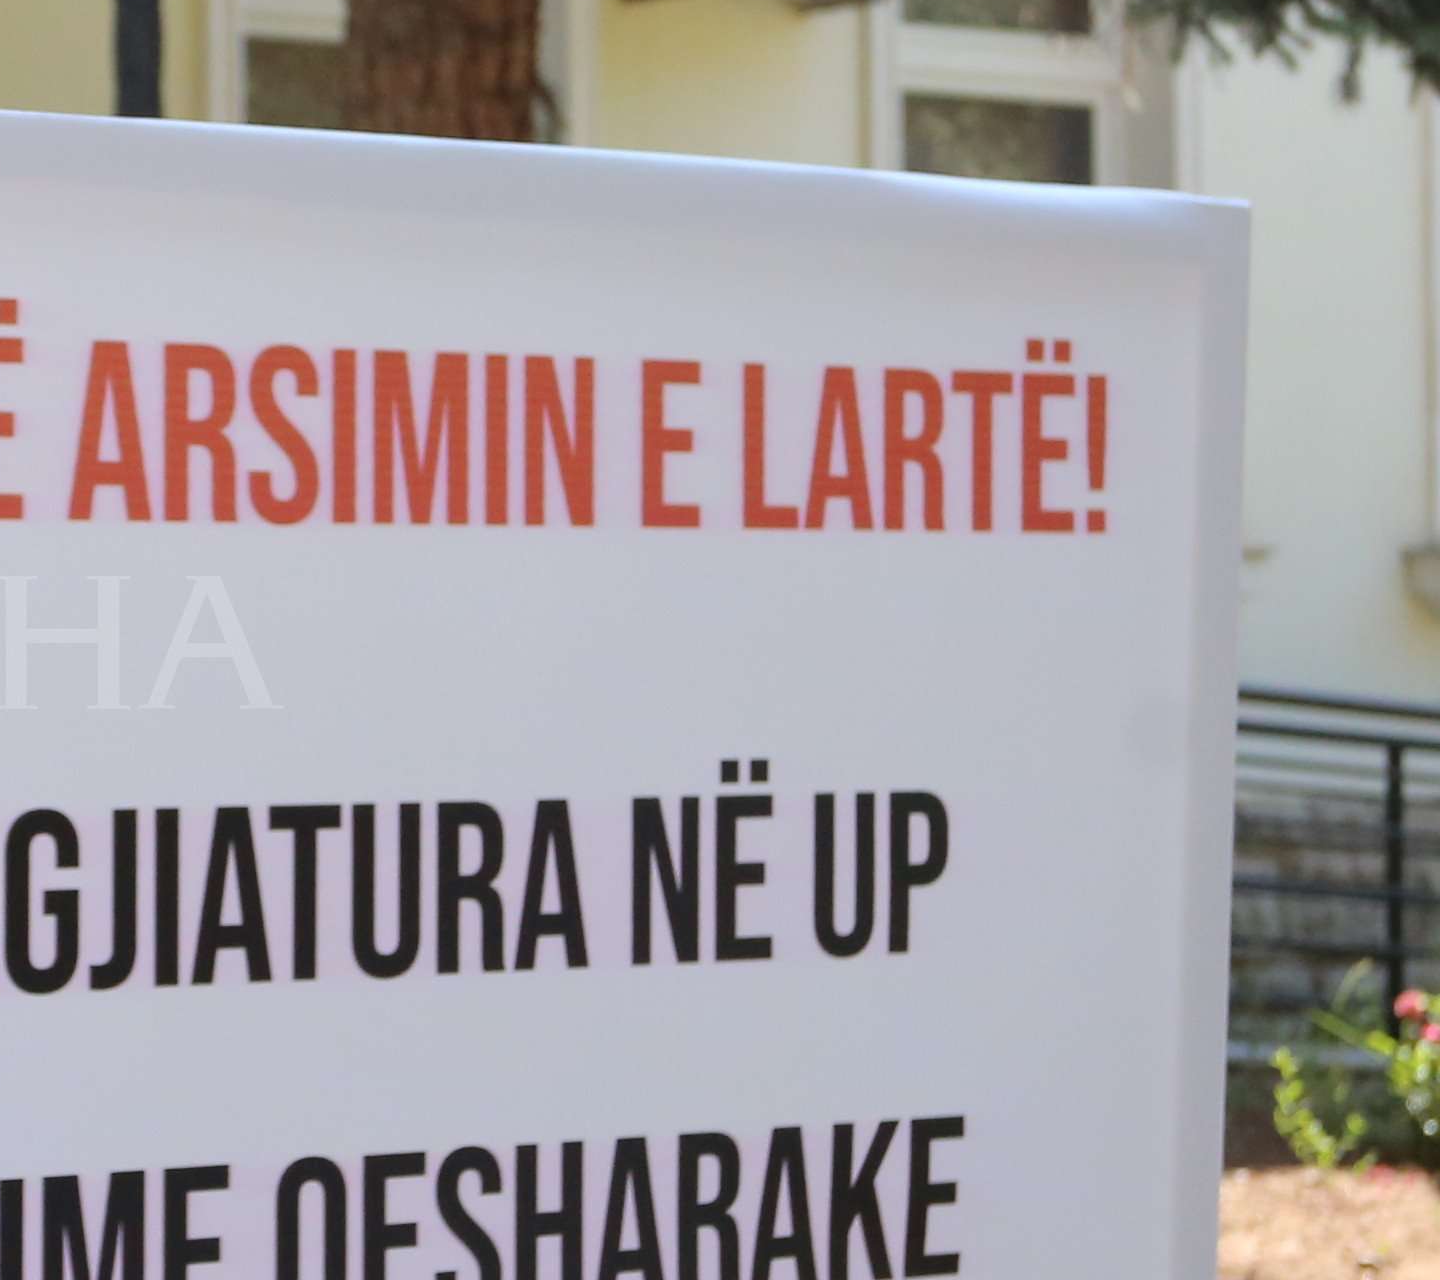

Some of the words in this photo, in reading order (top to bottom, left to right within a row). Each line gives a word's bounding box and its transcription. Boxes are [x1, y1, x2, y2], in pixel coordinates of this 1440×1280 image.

[69, 340, 595, 527] ARSIMIN
[642, 359, 701, 529] E
[744, 339, 1107, 534] LARTË!
[631, 758, 775, 966] NË
[813, 790, 951, 959] UP
